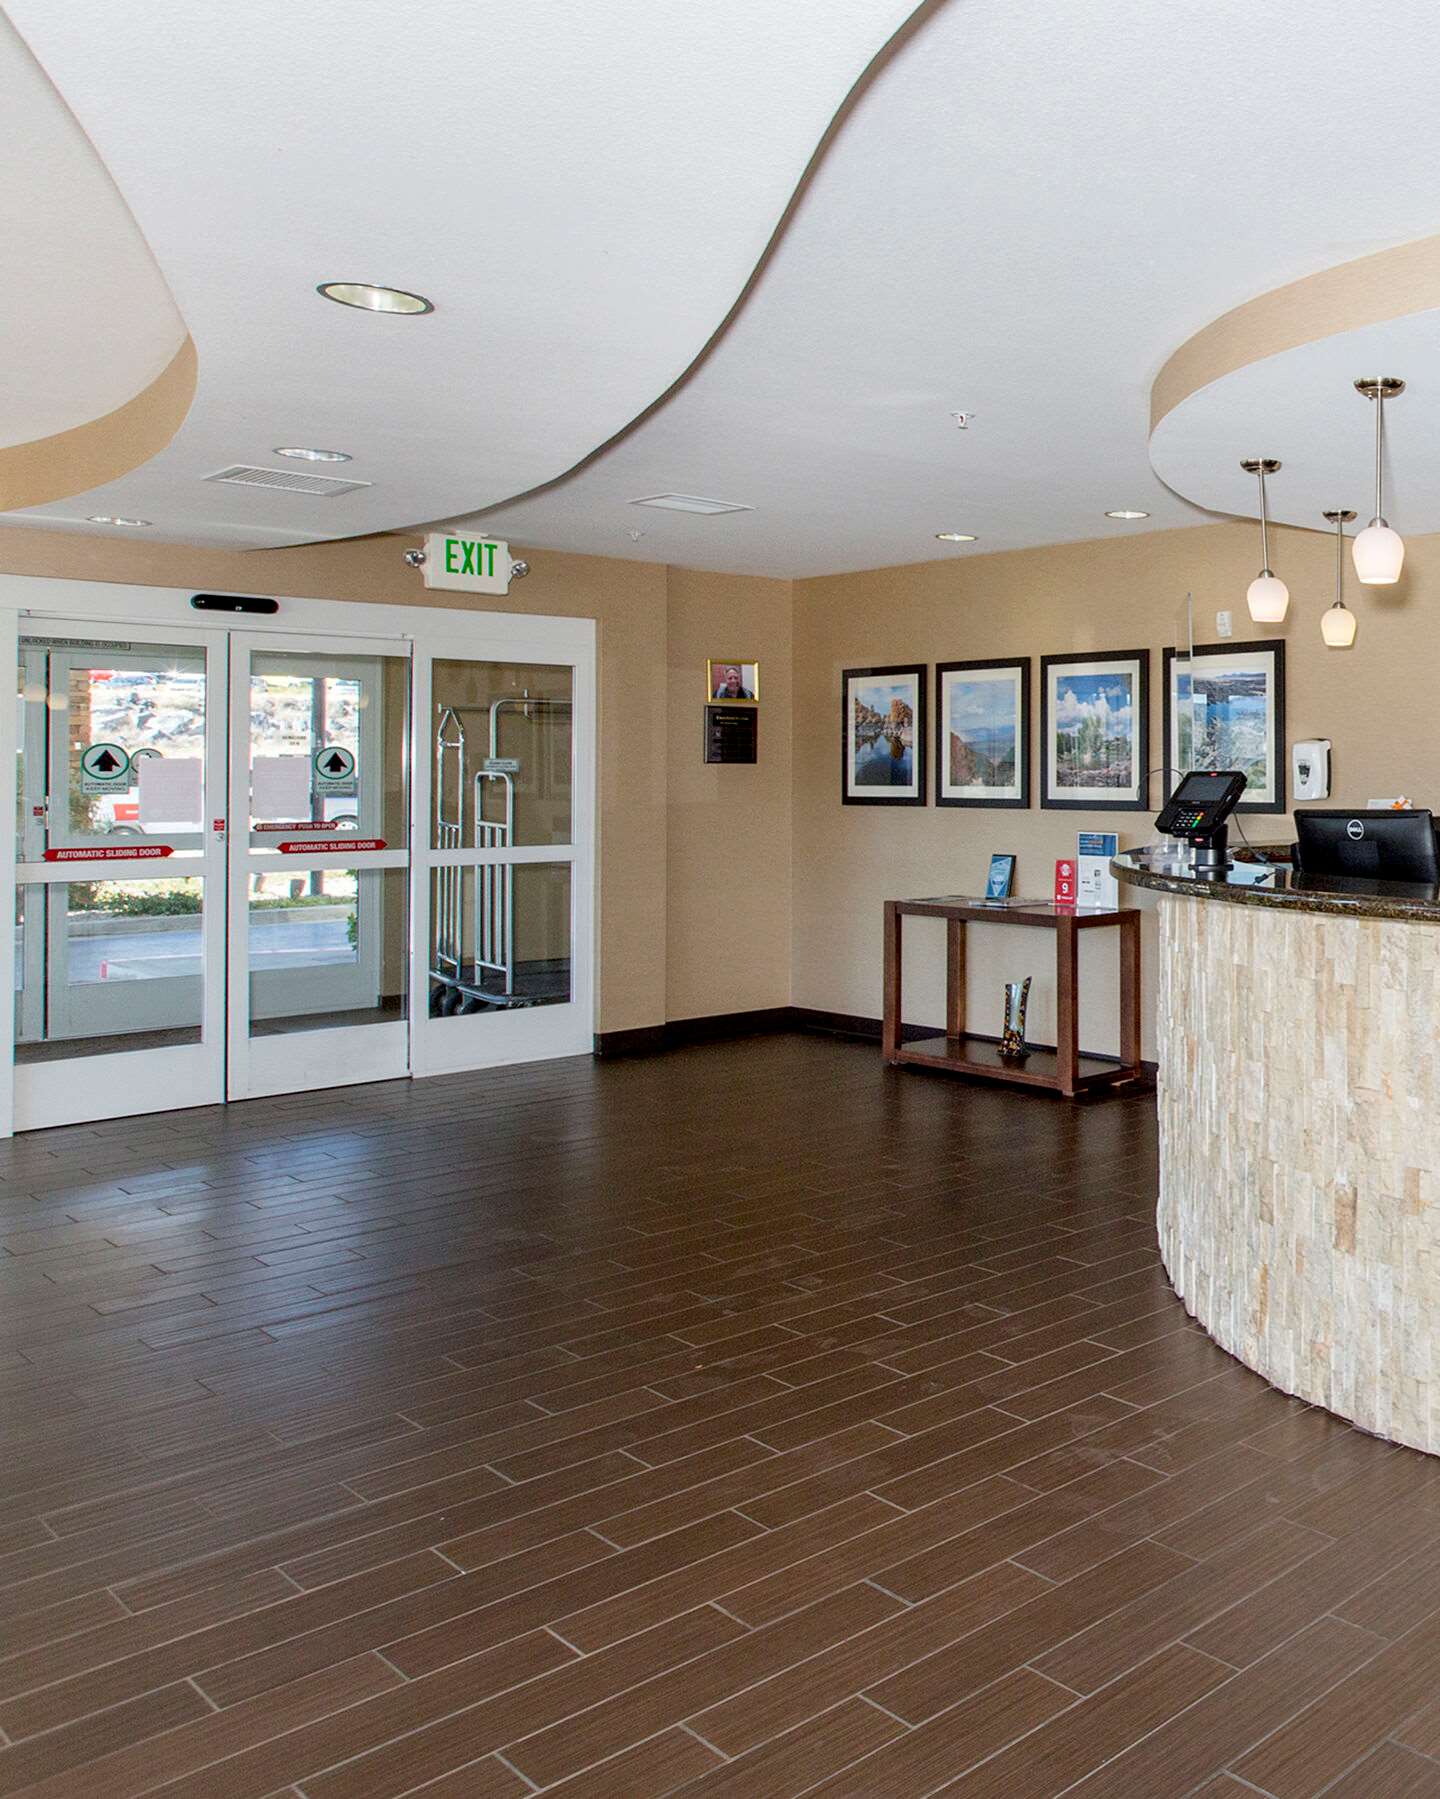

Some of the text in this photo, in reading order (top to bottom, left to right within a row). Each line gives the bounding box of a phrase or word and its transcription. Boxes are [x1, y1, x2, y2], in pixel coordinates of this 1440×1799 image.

[446, 539, 498, 577] EXIT
[288, 843, 329, 851] AUTOMATIC
[329, 842, 356, 850] SLIDING
[56, 848, 161, 859] AUTOMATIC SLIDING DOOR
[1062, 882, 1069, 894] 9
